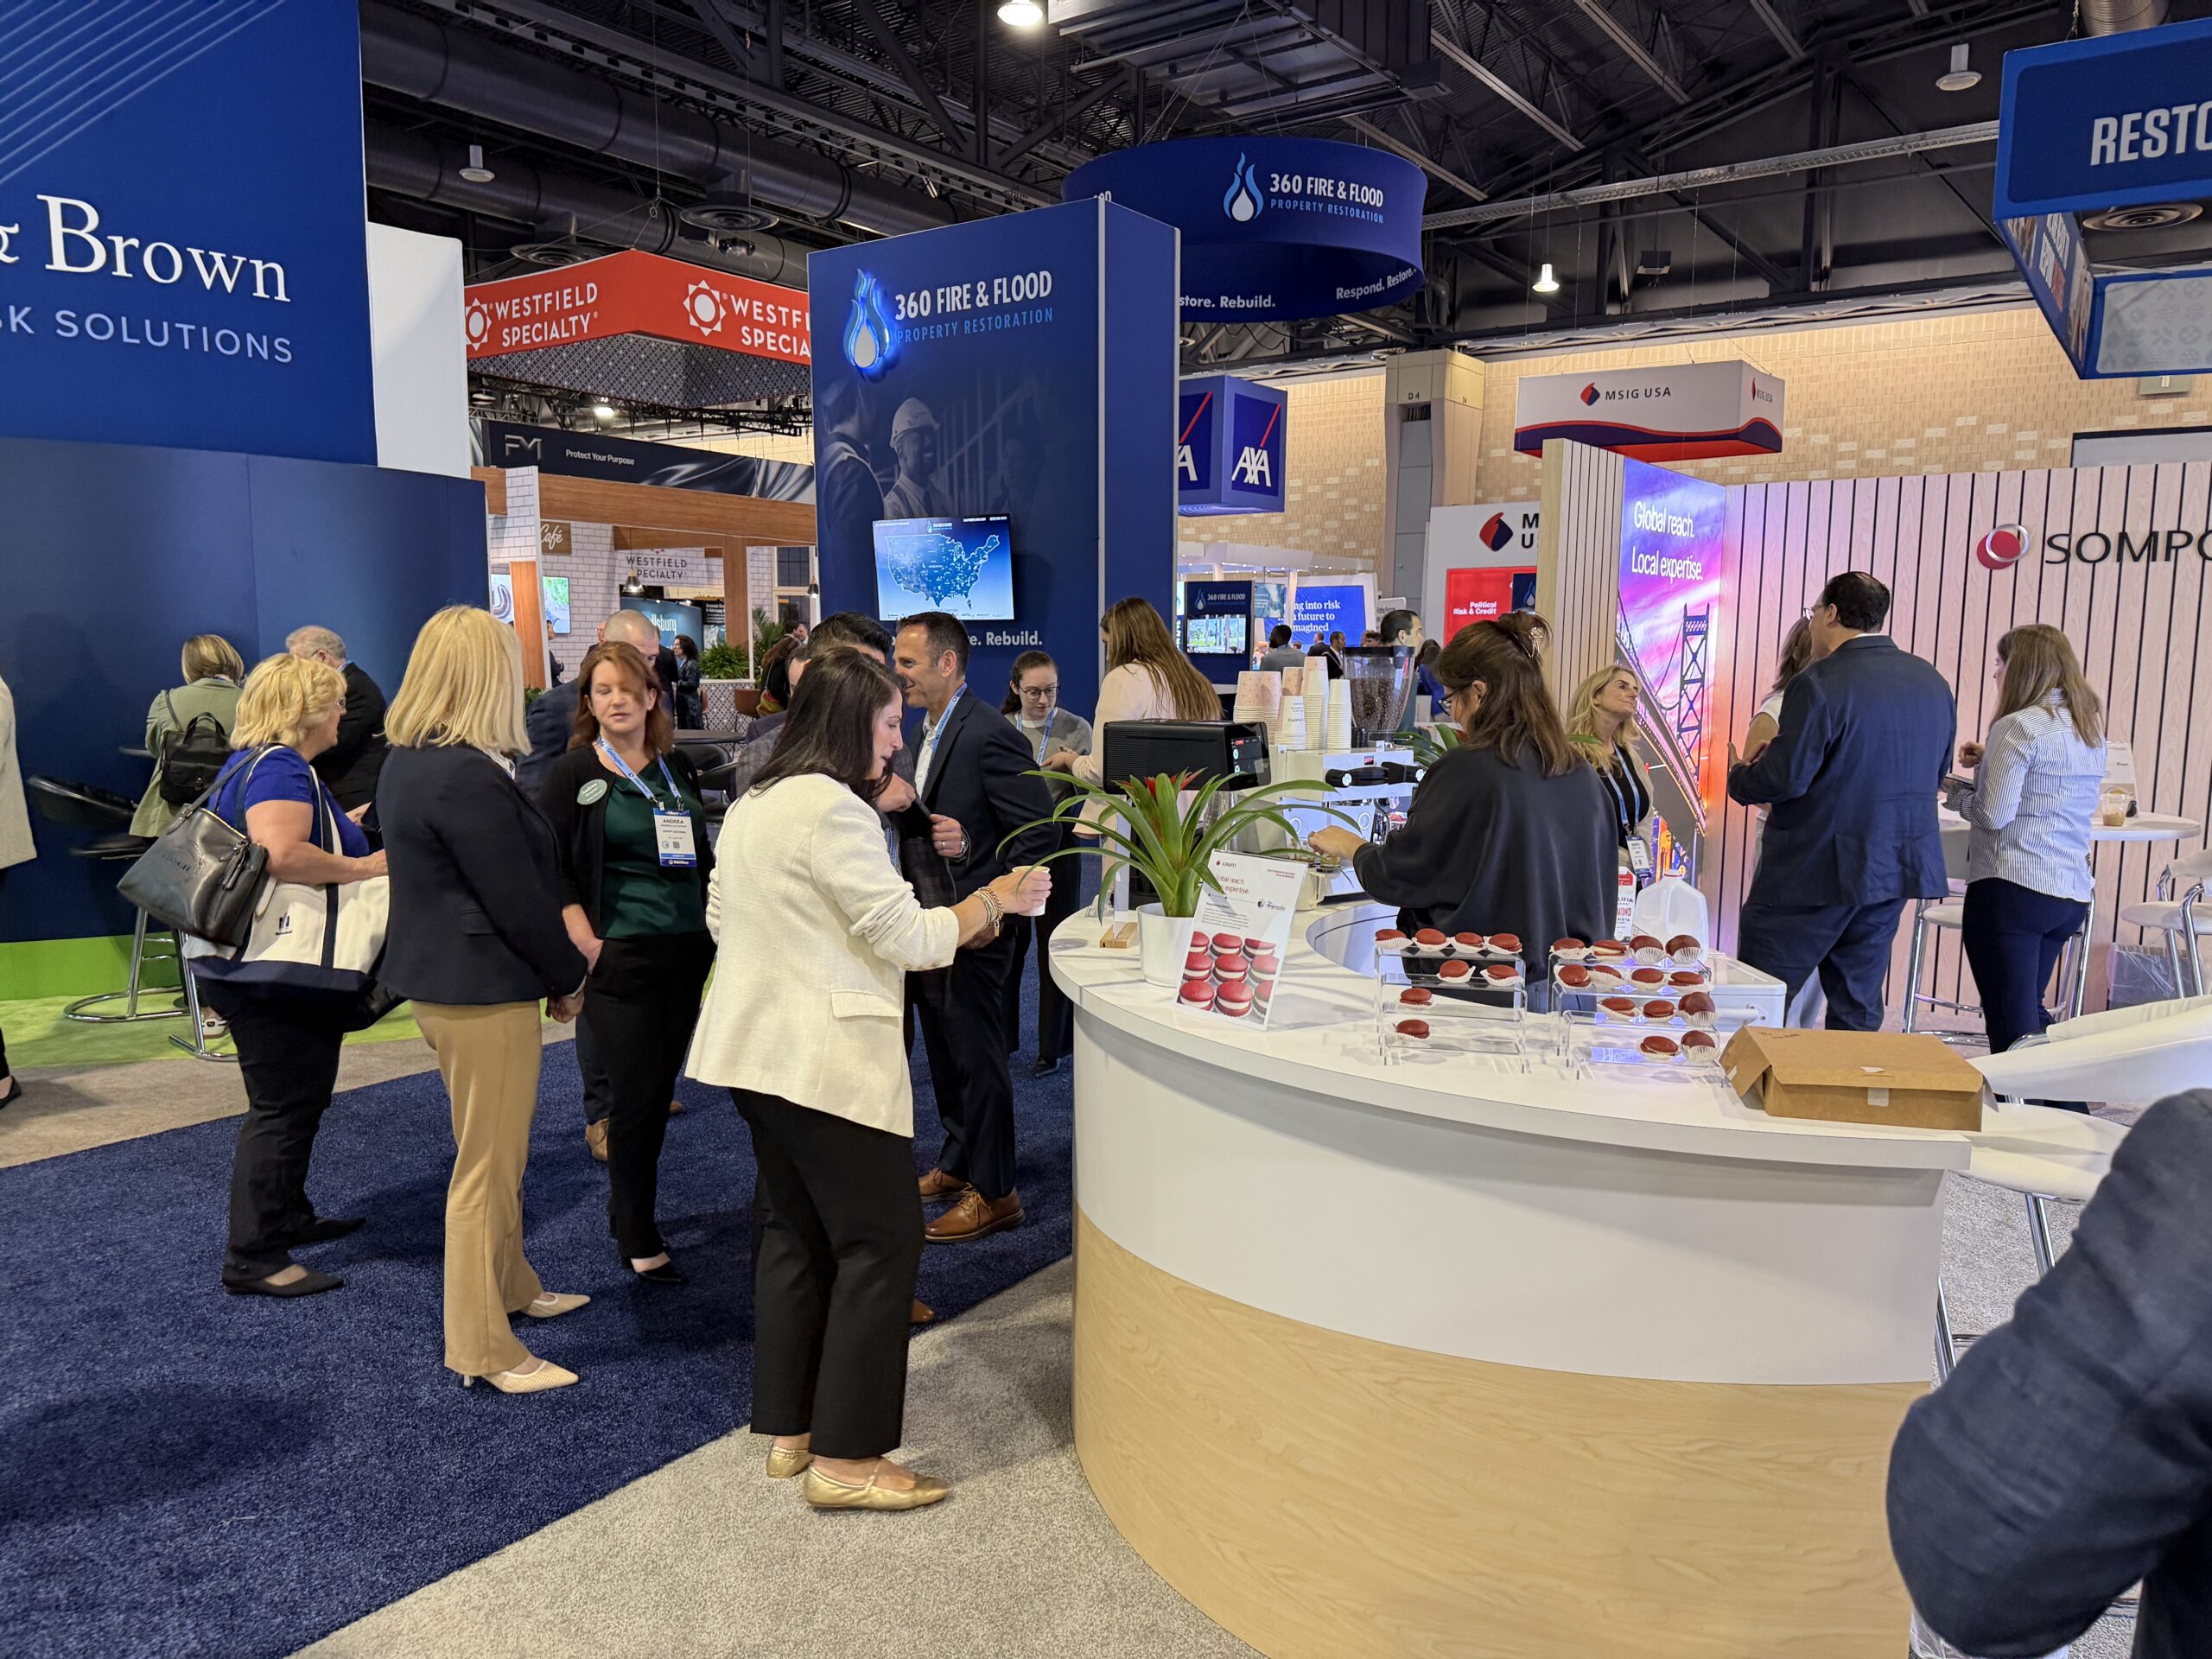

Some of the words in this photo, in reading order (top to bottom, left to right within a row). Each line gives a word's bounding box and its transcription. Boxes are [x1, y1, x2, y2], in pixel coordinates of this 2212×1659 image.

[1269, 173, 1302, 194] 360
[1306, 176, 1335, 198] FIRE
[1337, 181, 1347, 200] &
[1349, 182, 1383, 207] FLOOD
[1270, 199, 1324, 213] PROPERTY
[1327, 204, 1383, 224] RESTORATION
[36, 194, 291, 302] Brown
[895, 289, 931, 321] 360
[937, 283, 972, 314] FIRE
[976, 281, 989, 308] &
[994, 270, 1052, 305] FLOOD
[1336, 278, 1385, 300] Respond.
[1387, 268, 1414, 289] Restore.
[495, 282, 598, 321] WESTFIELD
[1220, 295, 1276, 308] Rebuild.
[0, 305, 35, 334] K
[55, 309, 292, 363] SOLUTIONS
[502, 312, 591, 347] SPECIALTY
[897, 322, 958, 344] PROPERTY
[964, 307, 1053, 335] RESTORATION
[1605, 389, 1639, 400] MSIG
[1644, 386, 1671, 398] USA
[505, 434, 543, 461] FM
[566, 448, 592, 460] Protect
[592, 453, 607, 461] Your
[607, 454, 635, 466] Purpose
[1231, 446, 1272, 487] AXA
[1634, 500, 1667, 533] Global
[1667, 512, 1695, 538] reach.
[626, 556, 688, 568] WESTFIELD
[636, 569, 683, 580] PECIALTY
[1631, 545, 1660, 575] Local
[1660, 555, 1704, 585] expertise.
[1298, 612, 1325, 621] future
[1305, 601, 1323, 610] into
[1324, 600, 1341, 610] risk
[986, 631, 1043, 645] Rebuild.
[1293, 622, 1330, 633] magined
